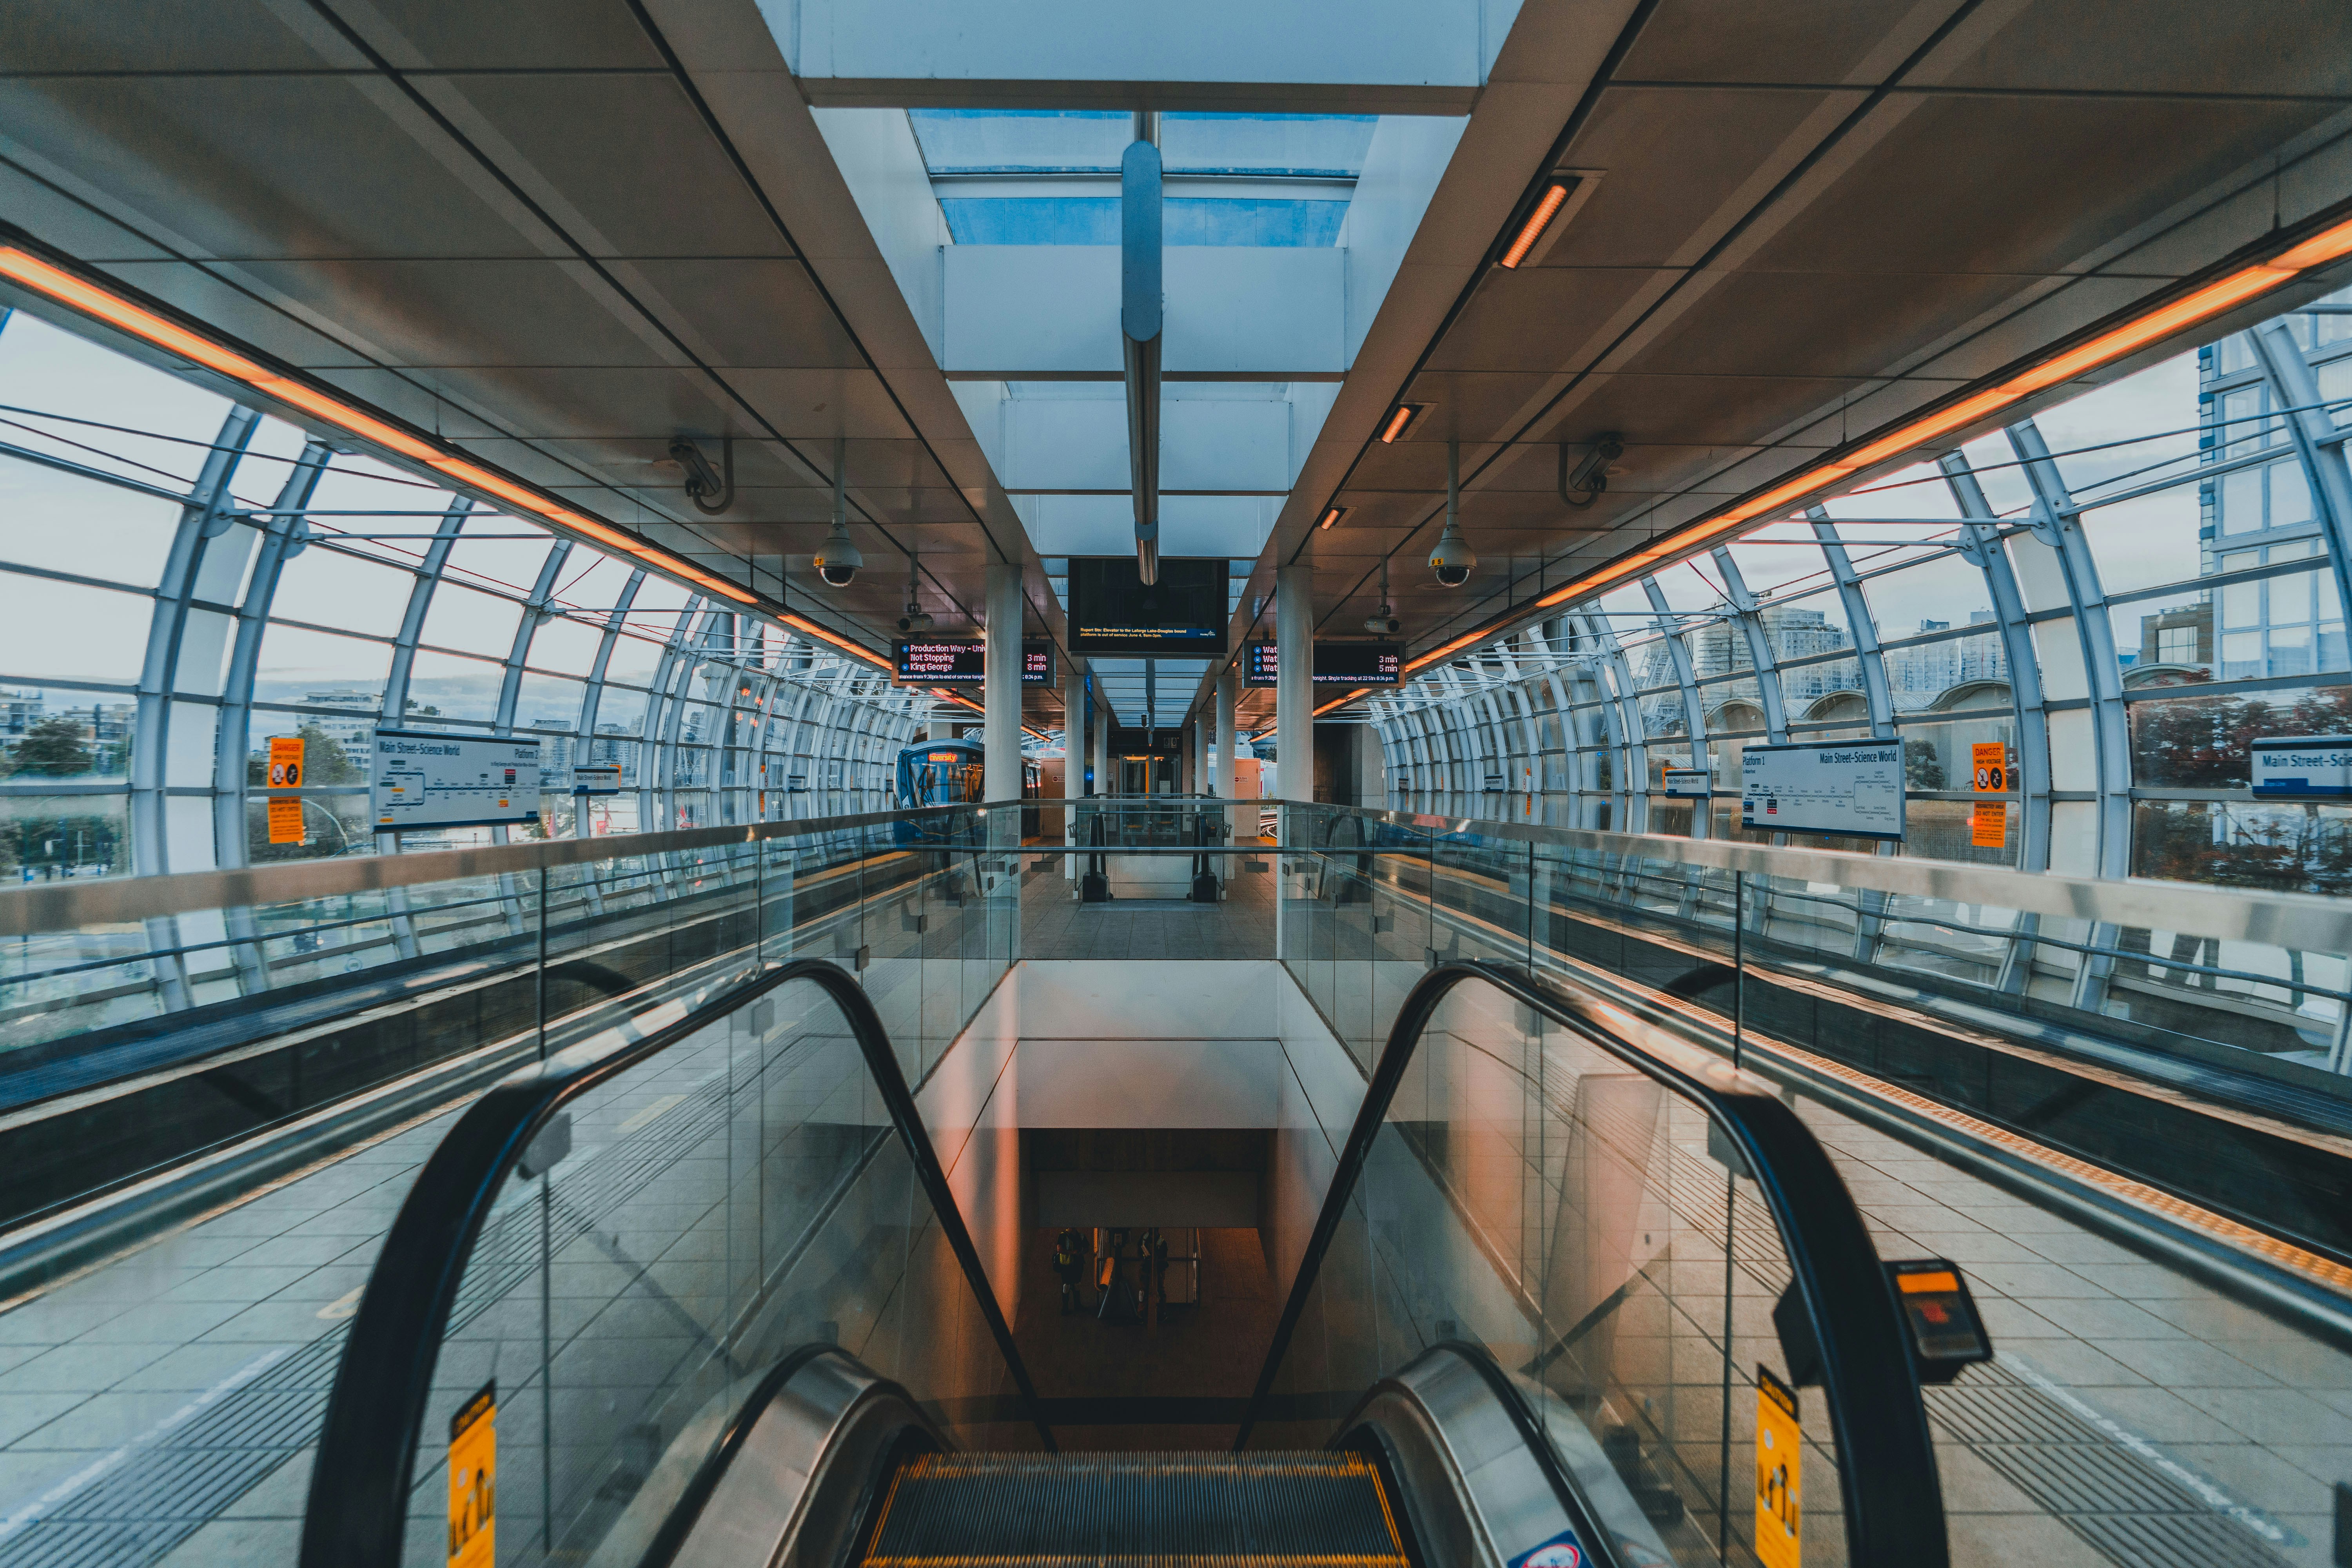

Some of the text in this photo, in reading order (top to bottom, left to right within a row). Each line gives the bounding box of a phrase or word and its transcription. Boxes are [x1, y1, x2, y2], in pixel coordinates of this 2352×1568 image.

[924, 653, 954, 662] Stopping
[910, 663, 952, 671] King George
[379, 741, 396, 753] Main
[443, 744, 460, 755] World
[515, 748, 538, 759] Platform 2
[1742, 755, 1765, 766] Platform 1
[1820, 753, 1833, 764] Main
[1878, 750, 1896, 762] World
[2262, 755, 2288, 767] Main
